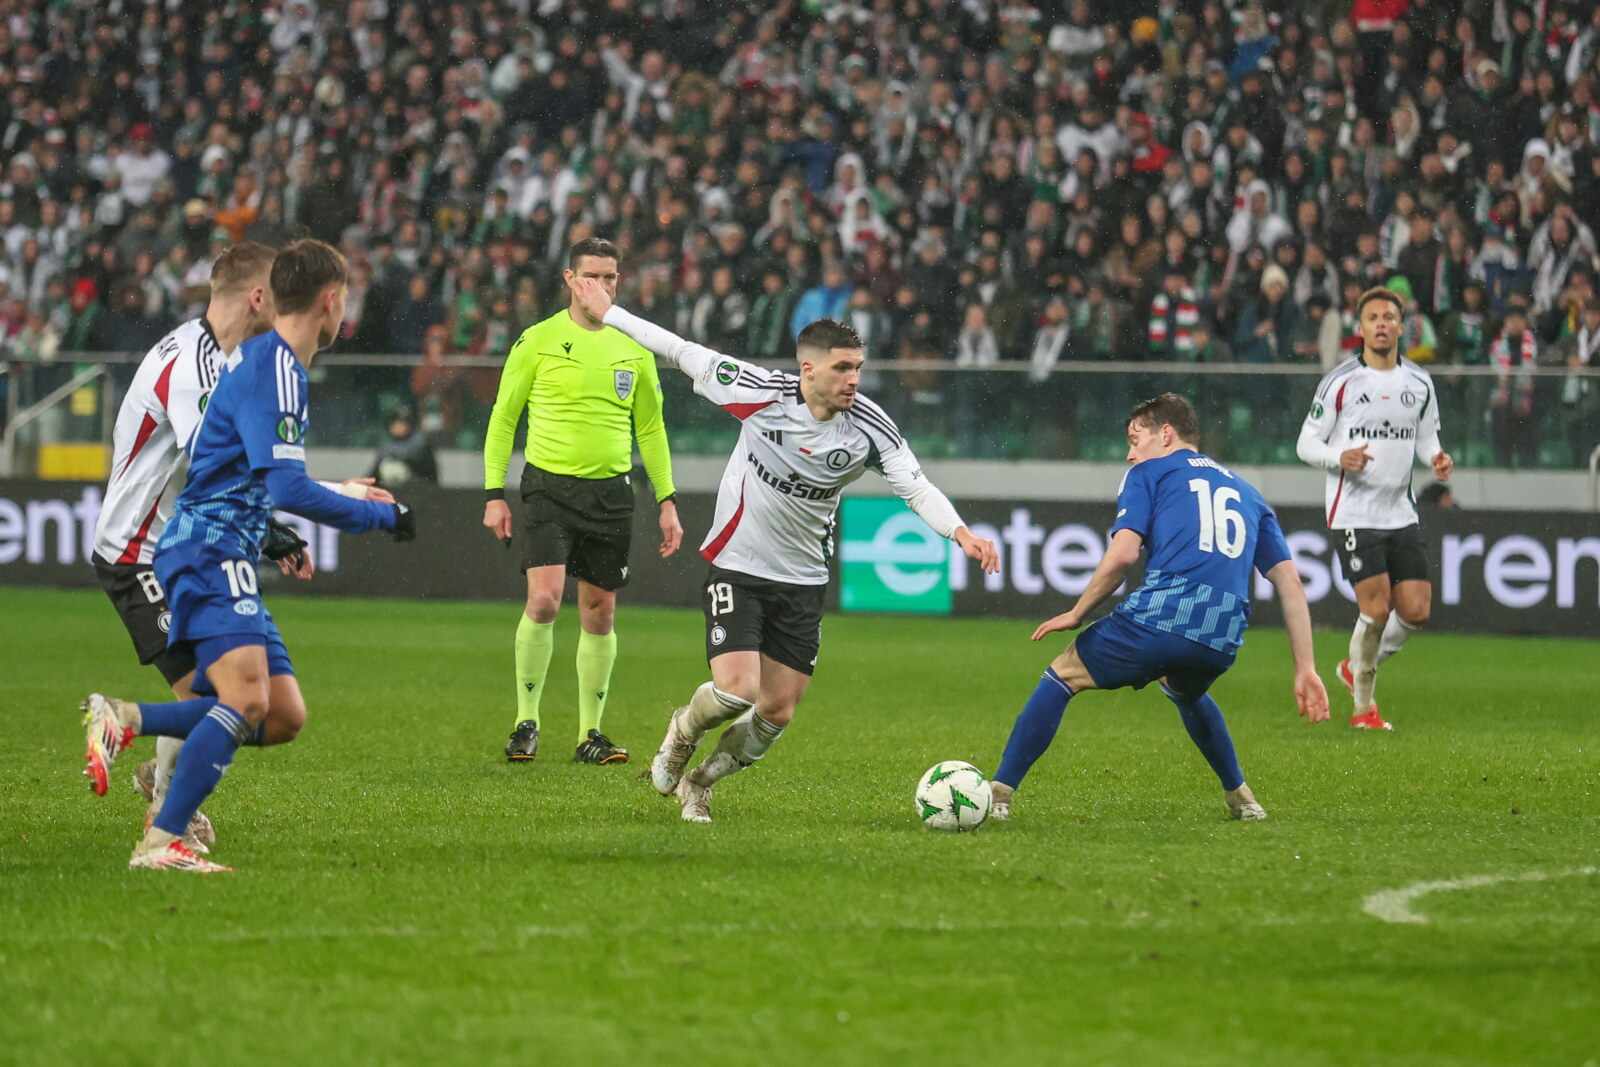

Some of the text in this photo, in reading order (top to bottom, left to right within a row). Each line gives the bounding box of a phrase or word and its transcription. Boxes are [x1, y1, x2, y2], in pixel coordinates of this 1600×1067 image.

[1349, 426, 1414, 440] Plus500
[748, 452, 837, 500] Plus500
[1188, 478, 1247, 559] 16
[1344, 528, 1357, 552] 3
[136, 570, 164, 604] 8
[221, 559, 258, 598] 10
[707, 582, 734, 617] 19
